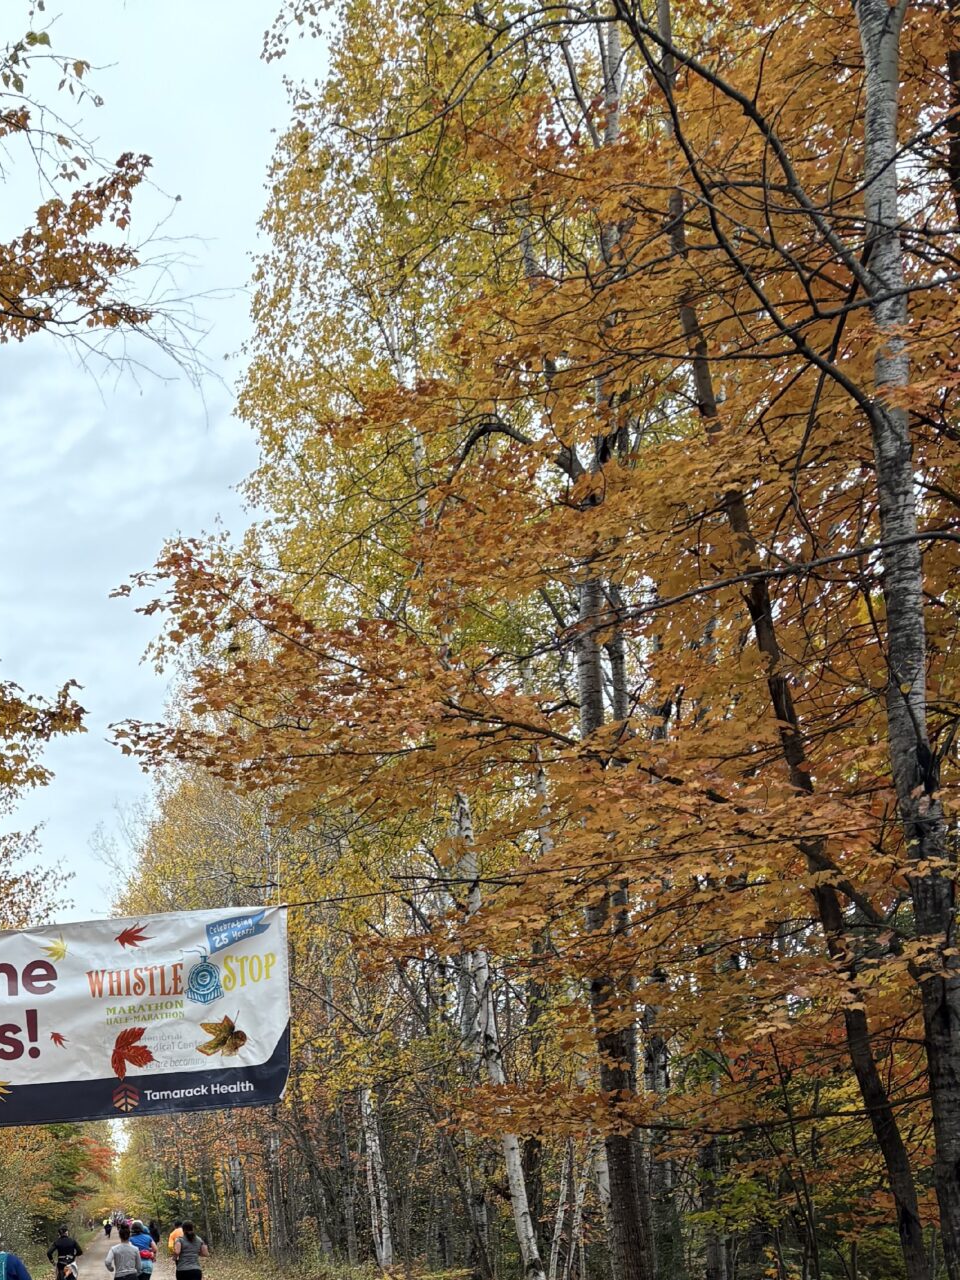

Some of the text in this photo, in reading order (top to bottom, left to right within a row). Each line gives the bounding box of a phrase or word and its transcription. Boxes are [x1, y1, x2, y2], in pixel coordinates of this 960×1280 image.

[209, 918, 253, 935] Celebrating
[212, 932, 229, 948] 25
[86, 952, 276, 998] WHISTLE STOP
[106, 1000, 184, 1016] MARATHON
[106, 1011, 185, 1025] HALF-MARATHON
[144, 1080, 254, 1101] Tamarack Health
